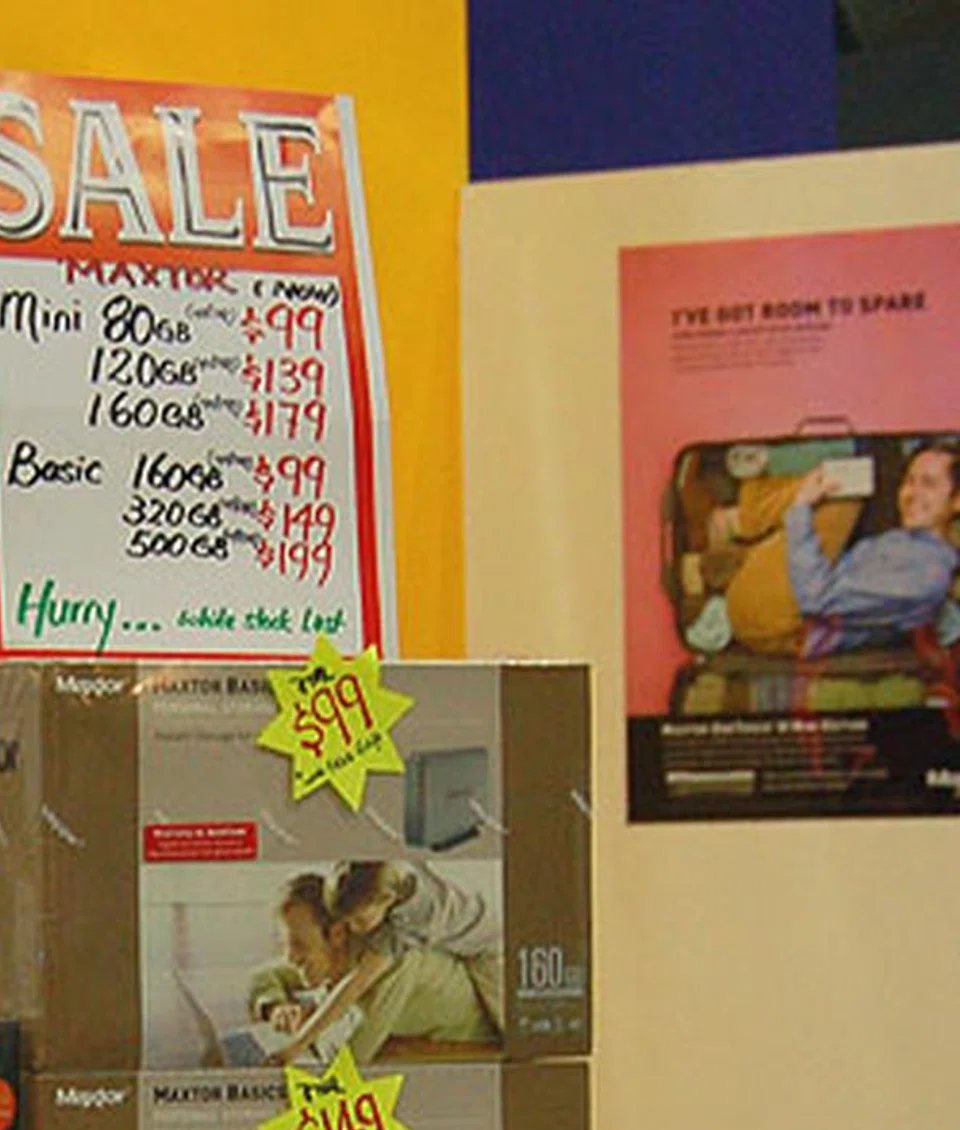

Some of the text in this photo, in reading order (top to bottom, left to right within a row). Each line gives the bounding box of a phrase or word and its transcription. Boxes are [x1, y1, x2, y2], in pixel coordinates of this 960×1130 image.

[60, 259, 238, 294] MAXTOR
[0, 291, 82, 342] Mini
[102, 294, 192, 346] 80GB
[241, 303, 324, 350] $99
[858, 290, 928, 314] SPARE
[90, 347, 199, 388] 120GB
[241, 353, 325, 397] $139
[87, 391, 206, 431] 160GB
[242, 399, 327, 442] $179
[7, 440, 104, 487] Basic
[132, 452, 224, 493] 160GB
[253, 454, 326, 499] $99
[257, 500, 336, 545] $149
[257, 540, 334, 588] $199
[294, 672, 372, 758] $99
[55, 1086, 127, 1109] Maxtor
